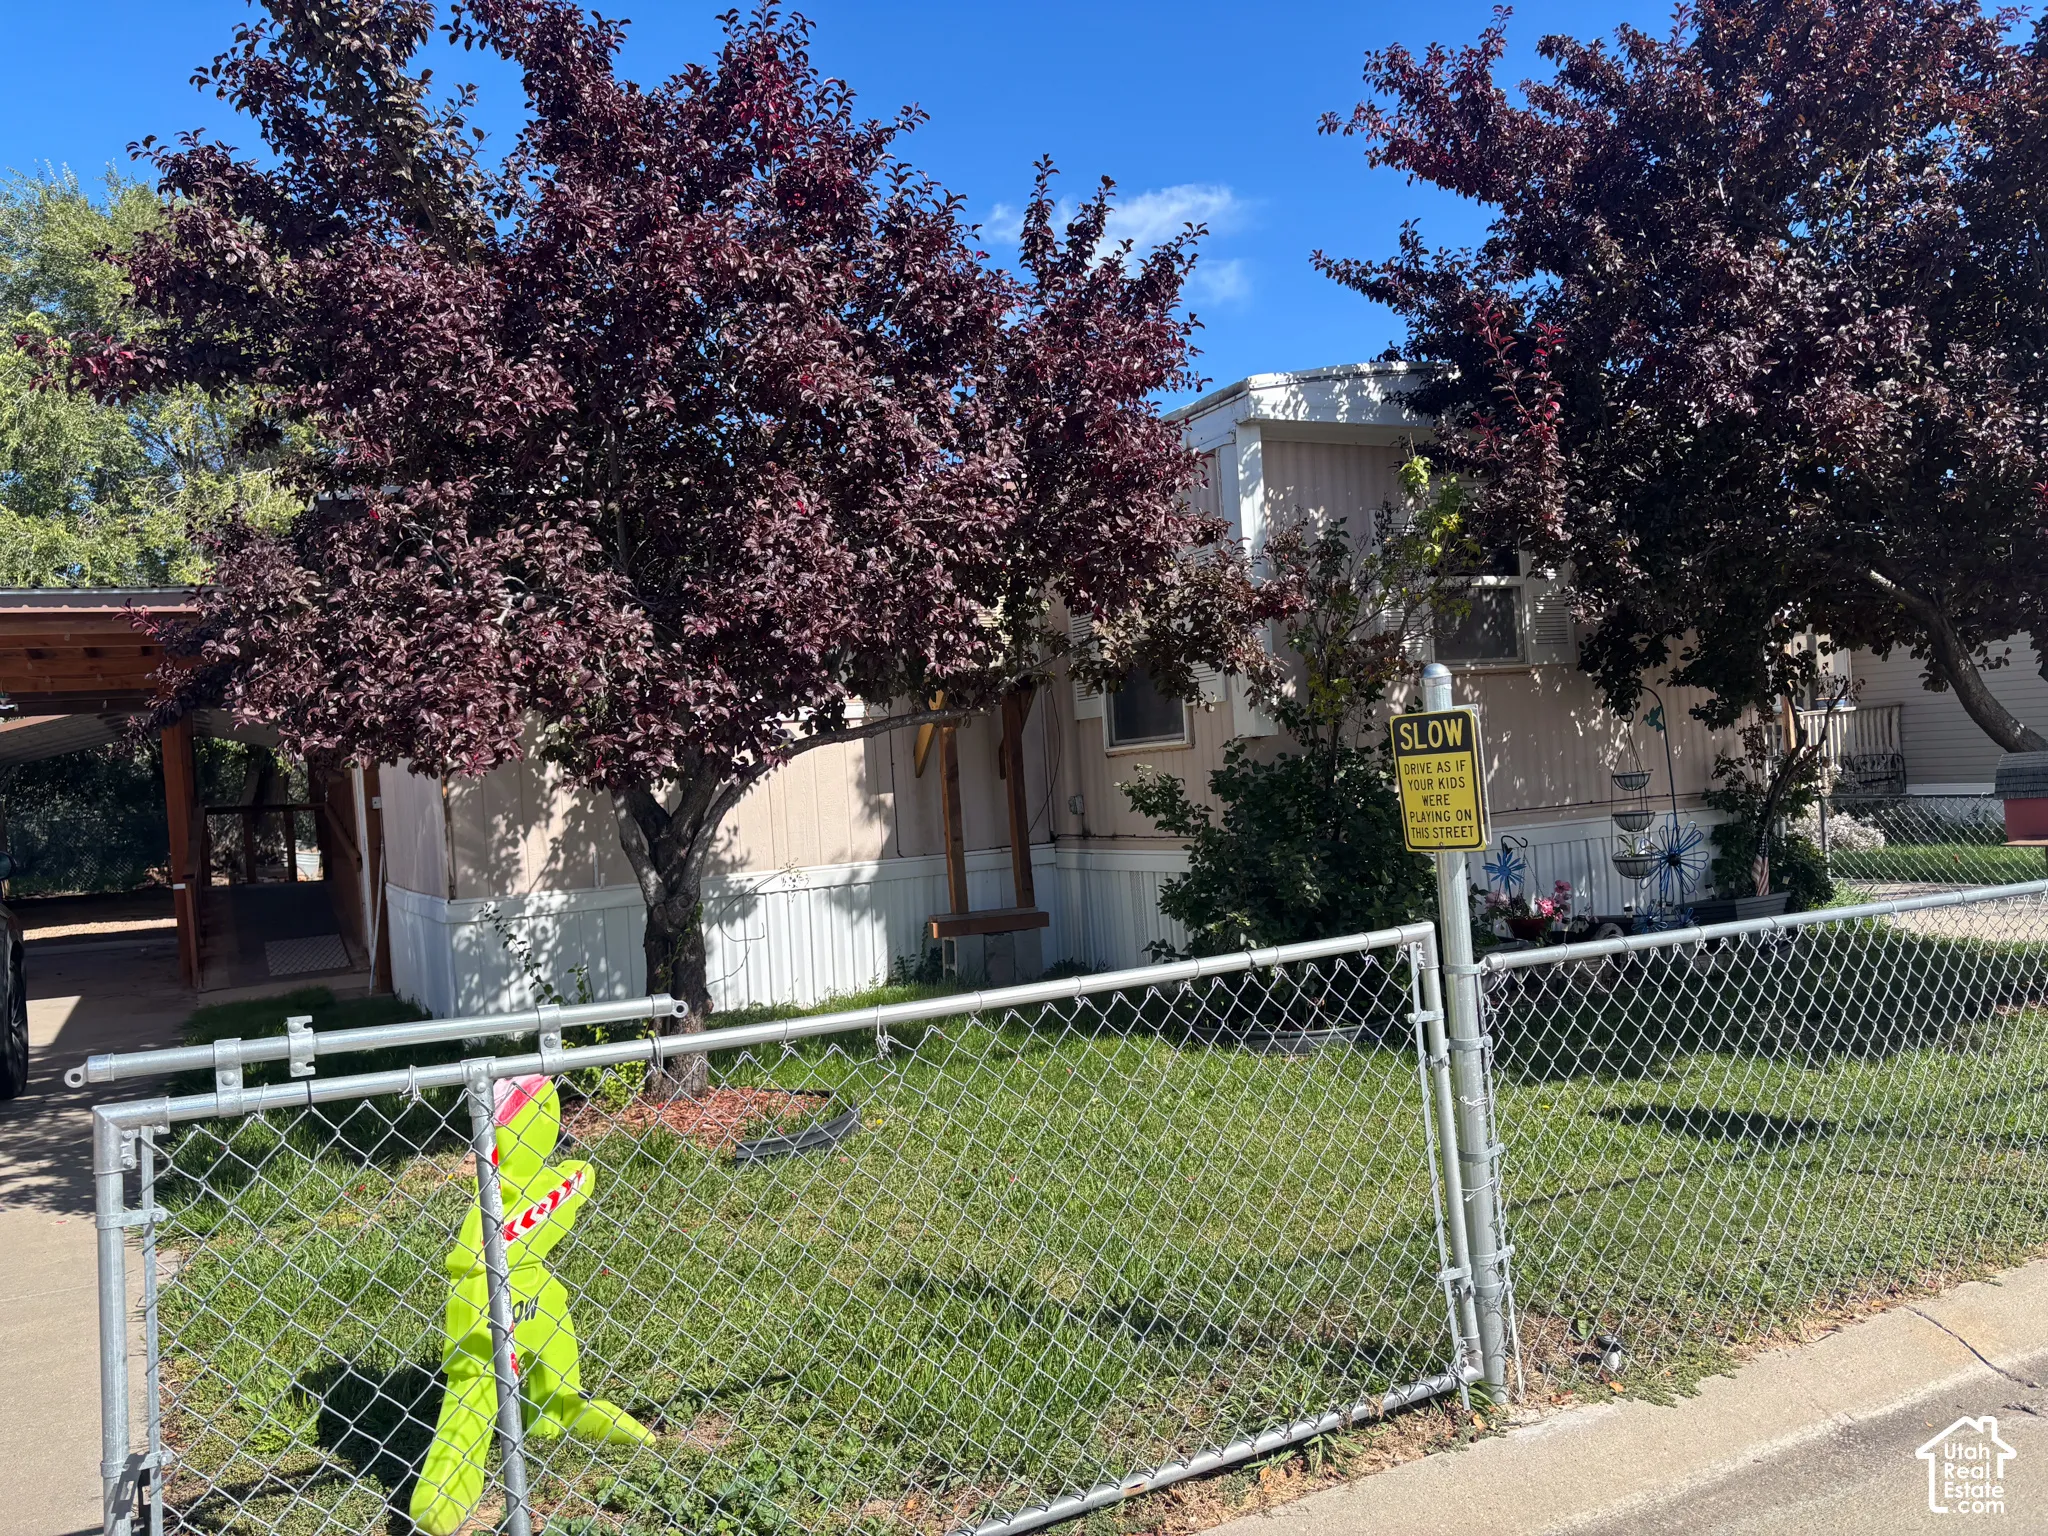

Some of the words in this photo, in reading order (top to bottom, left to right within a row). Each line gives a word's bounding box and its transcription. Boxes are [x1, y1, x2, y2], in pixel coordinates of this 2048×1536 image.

[1400, 718, 1462, 750] SLOW
[1404, 762, 1432, 775] DRIVE
[1436, 761, 1451, 773] AS
[1456, 760, 1466, 772] IF
[1408, 779, 1434, 791] YOUR
[1438, 777, 1466, 789] KIDS
[1422, 794, 1450, 806] WERE
[1410, 811, 1451, 823] PLAYING
[1456, 809, 1472, 820] ON
[1411, 827, 1429, 839] THIS
[1433, 826, 1474, 838] STREET
